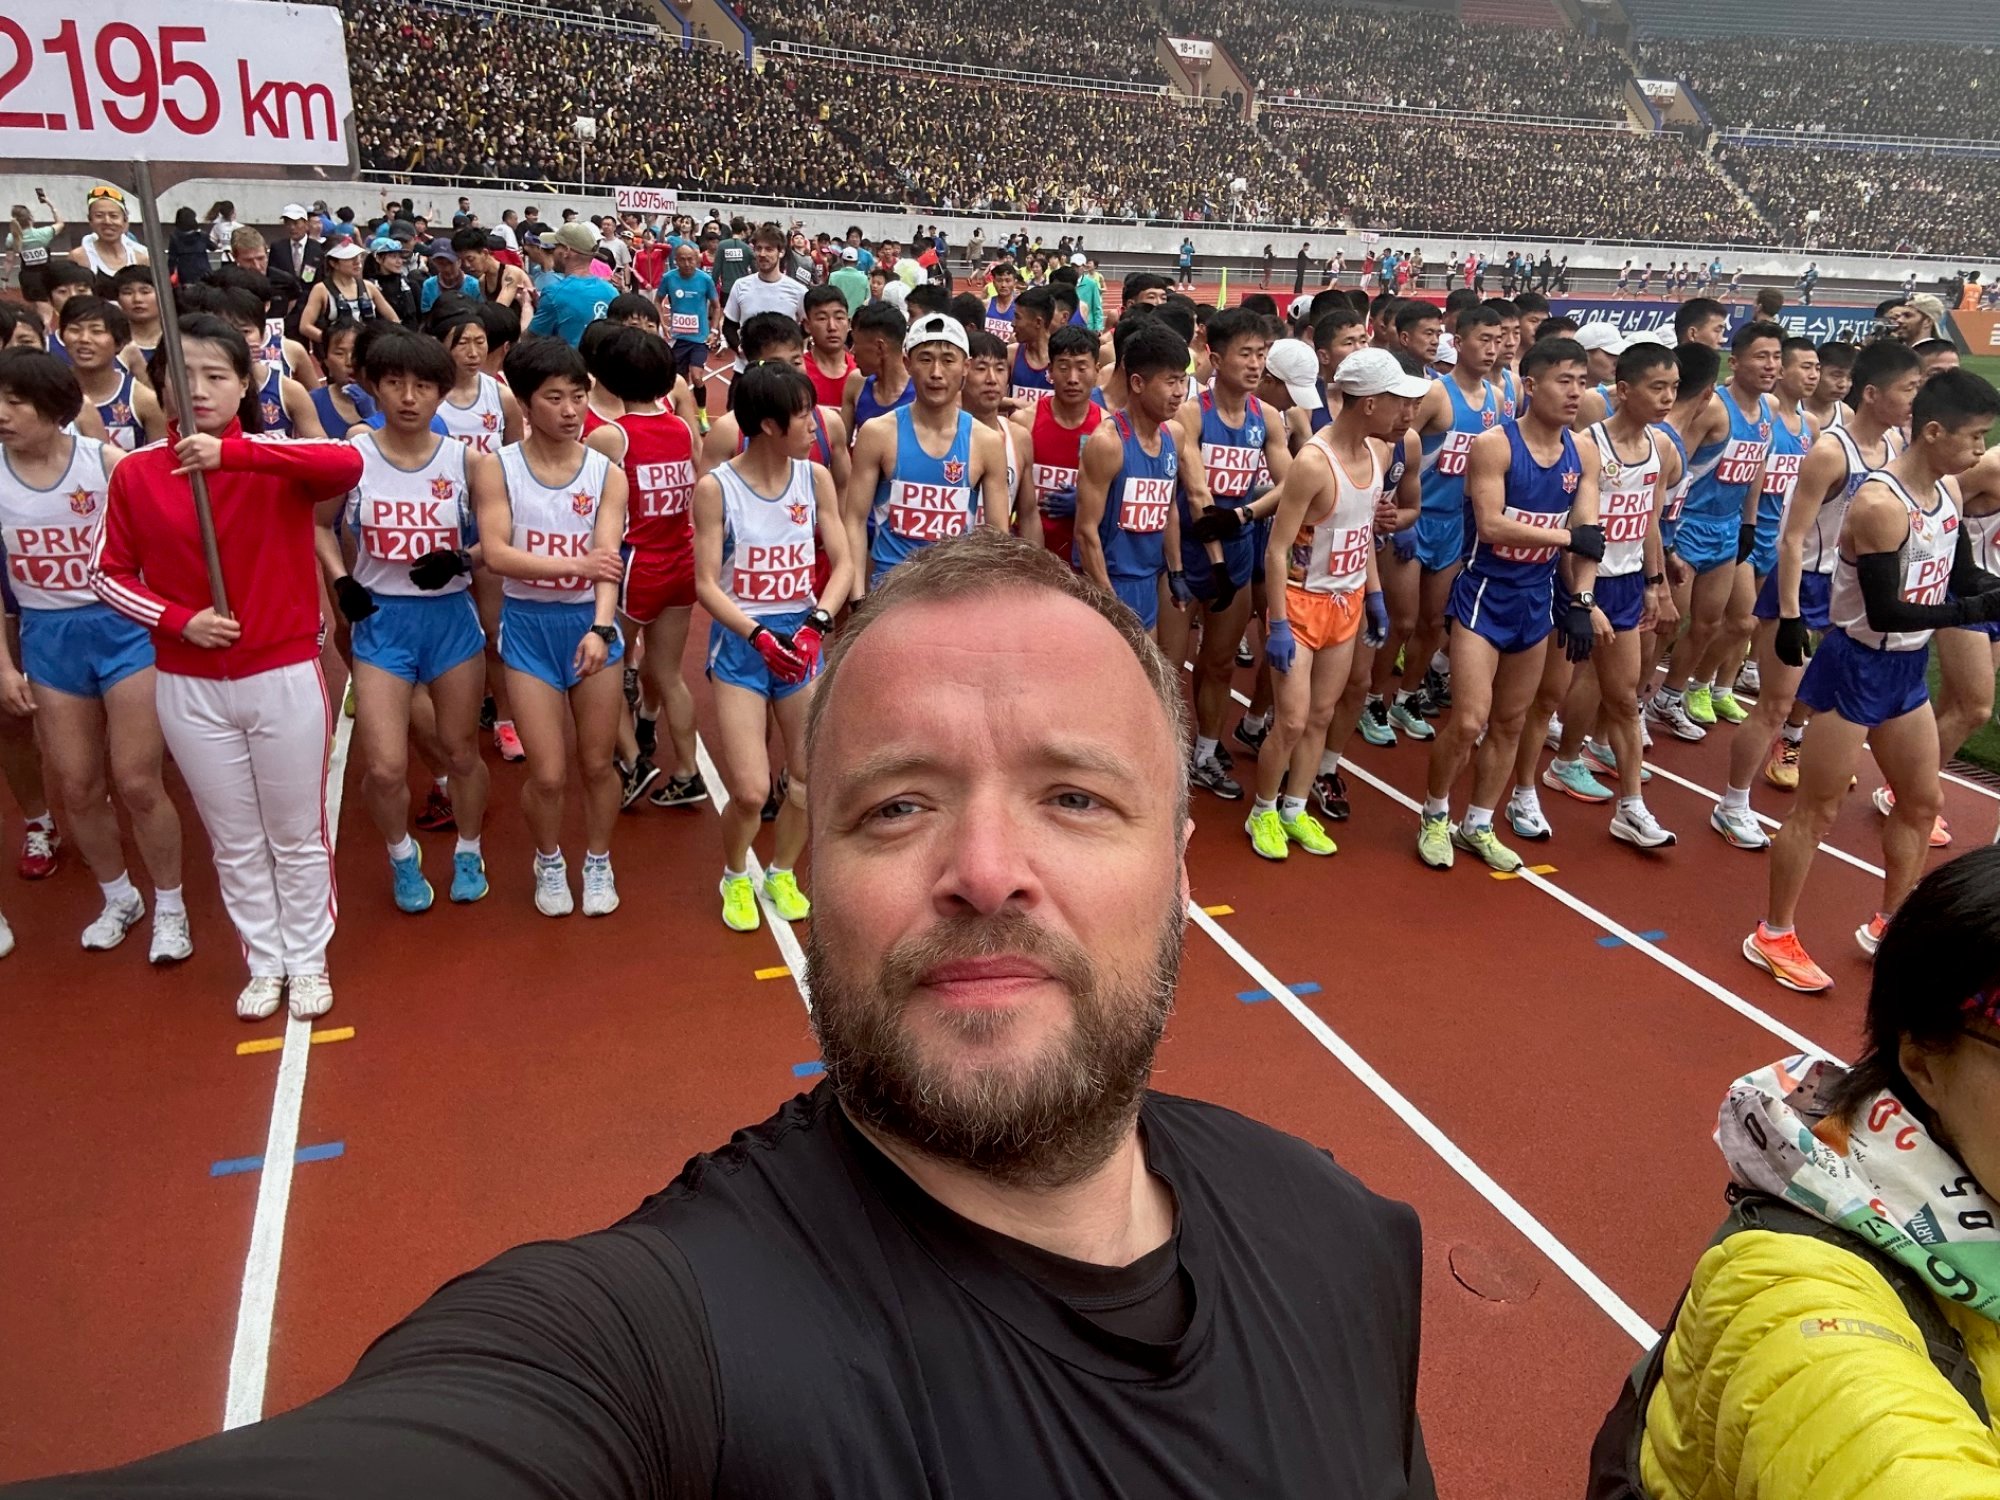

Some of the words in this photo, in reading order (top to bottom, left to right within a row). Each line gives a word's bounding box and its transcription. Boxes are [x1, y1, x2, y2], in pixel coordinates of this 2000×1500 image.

[238, 59, 338, 142] km
[672, 315, 698, 326] 5008
[988, 319, 1010, 331] PRK
[1210, 446, 1255, 469] PRK
[1440, 453, 1467, 474] 10
[1734, 442, 1767, 460] PRK
[1775, 456, 1804, 472] PR
[649, 463, 689, 488] PRK
[643, 487, 692, 517] 1228
[902, 484, 959, 510] PRK
[1135, 480, 1171, 502] PRK
[1608, 491, 1651, 513] PRK
[373, 501, 442, 527] PRK
[893, 509, 963, 540] 1246
[1122, 505, 1169, 531] 1045
[16, 525, 95, 554] PRK
[526, 529, 590, 558] PRK
[1345, 524, 1369, 550] PR
[748, 542, 807, 569] PRK
[1332, 545, 1369, 575] 105
[15, 558, 89, 589] 120
[737, 569, 813, 600] 1204
